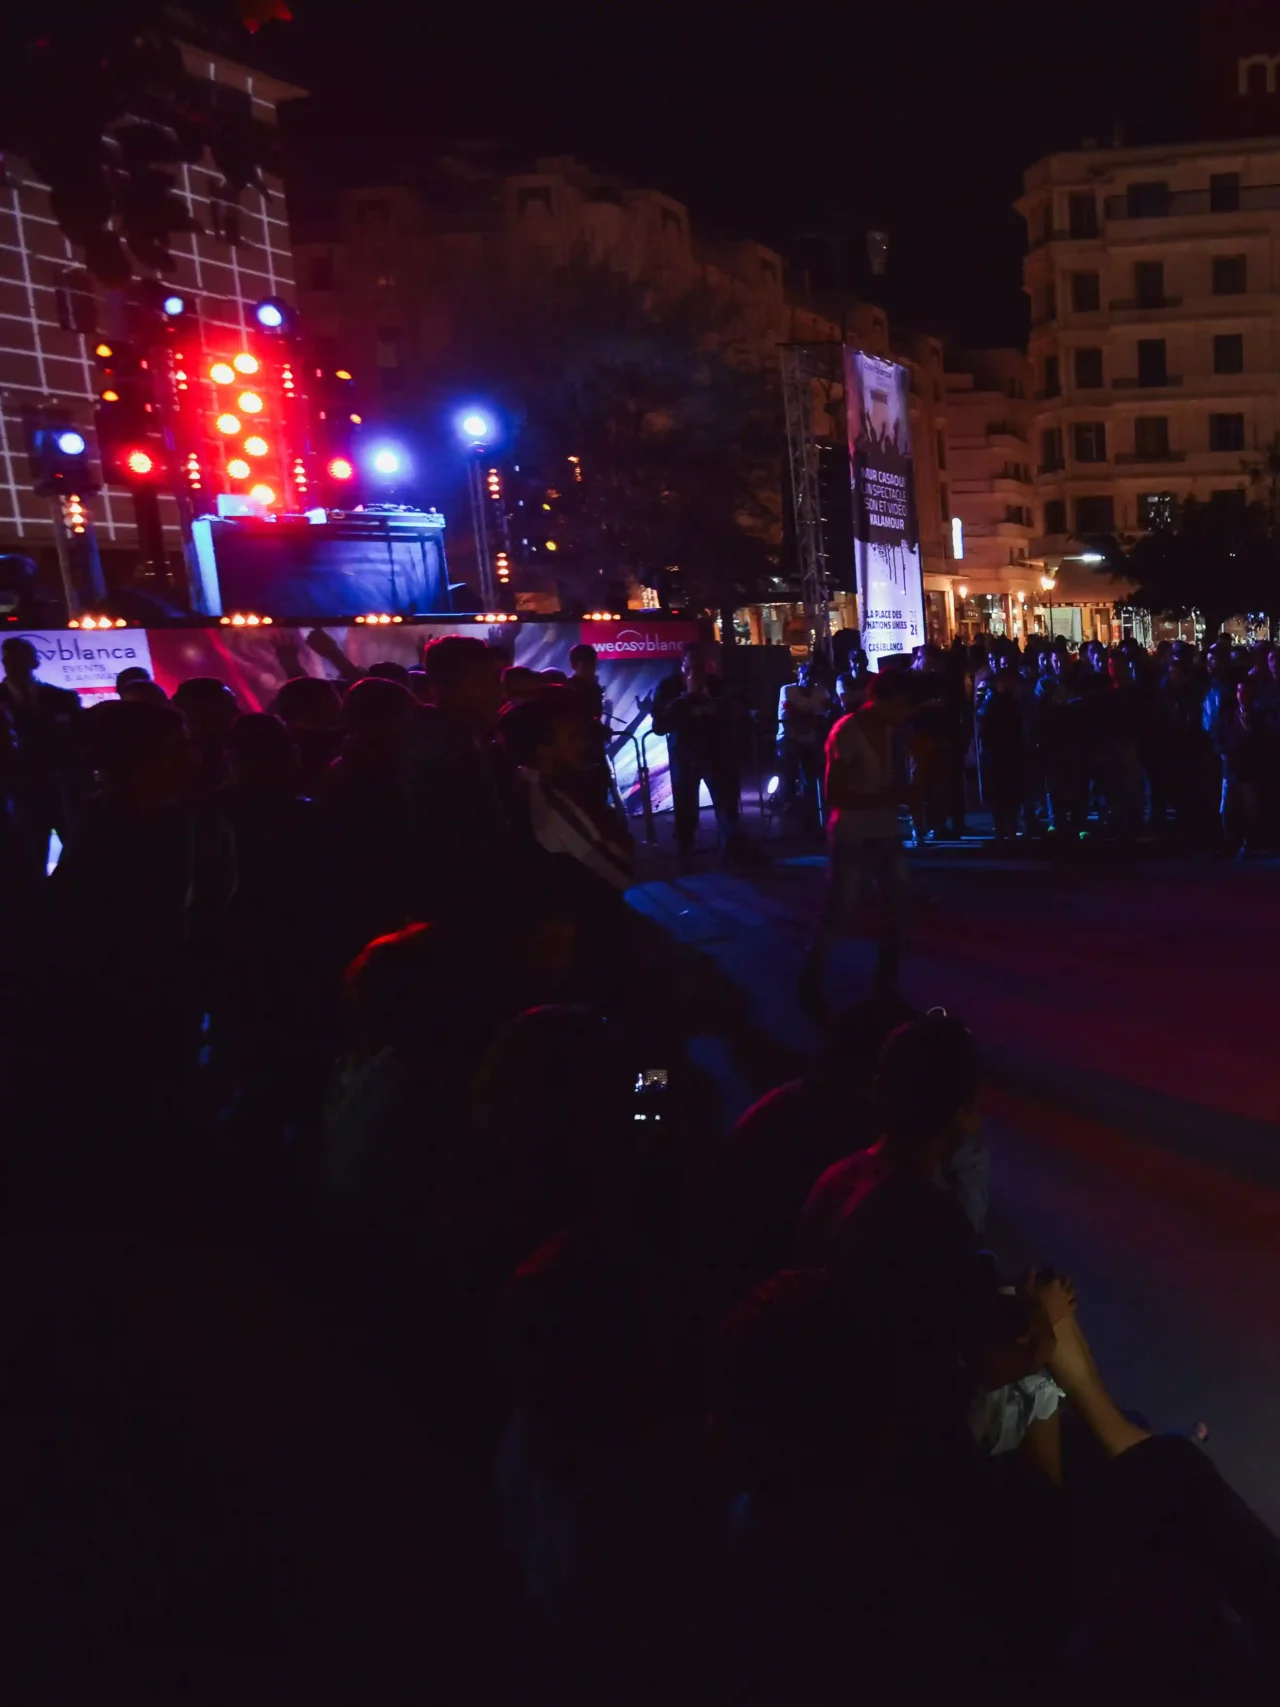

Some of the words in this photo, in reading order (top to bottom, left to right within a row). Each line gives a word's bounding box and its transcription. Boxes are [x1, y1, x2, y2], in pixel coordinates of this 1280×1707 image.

[864, 497, 878, 511] SON
[892, 610, 902, 619] DES
[868, 642, 904, 652] CASABLANCA
[62, 664, 106, 673] EVENTS
